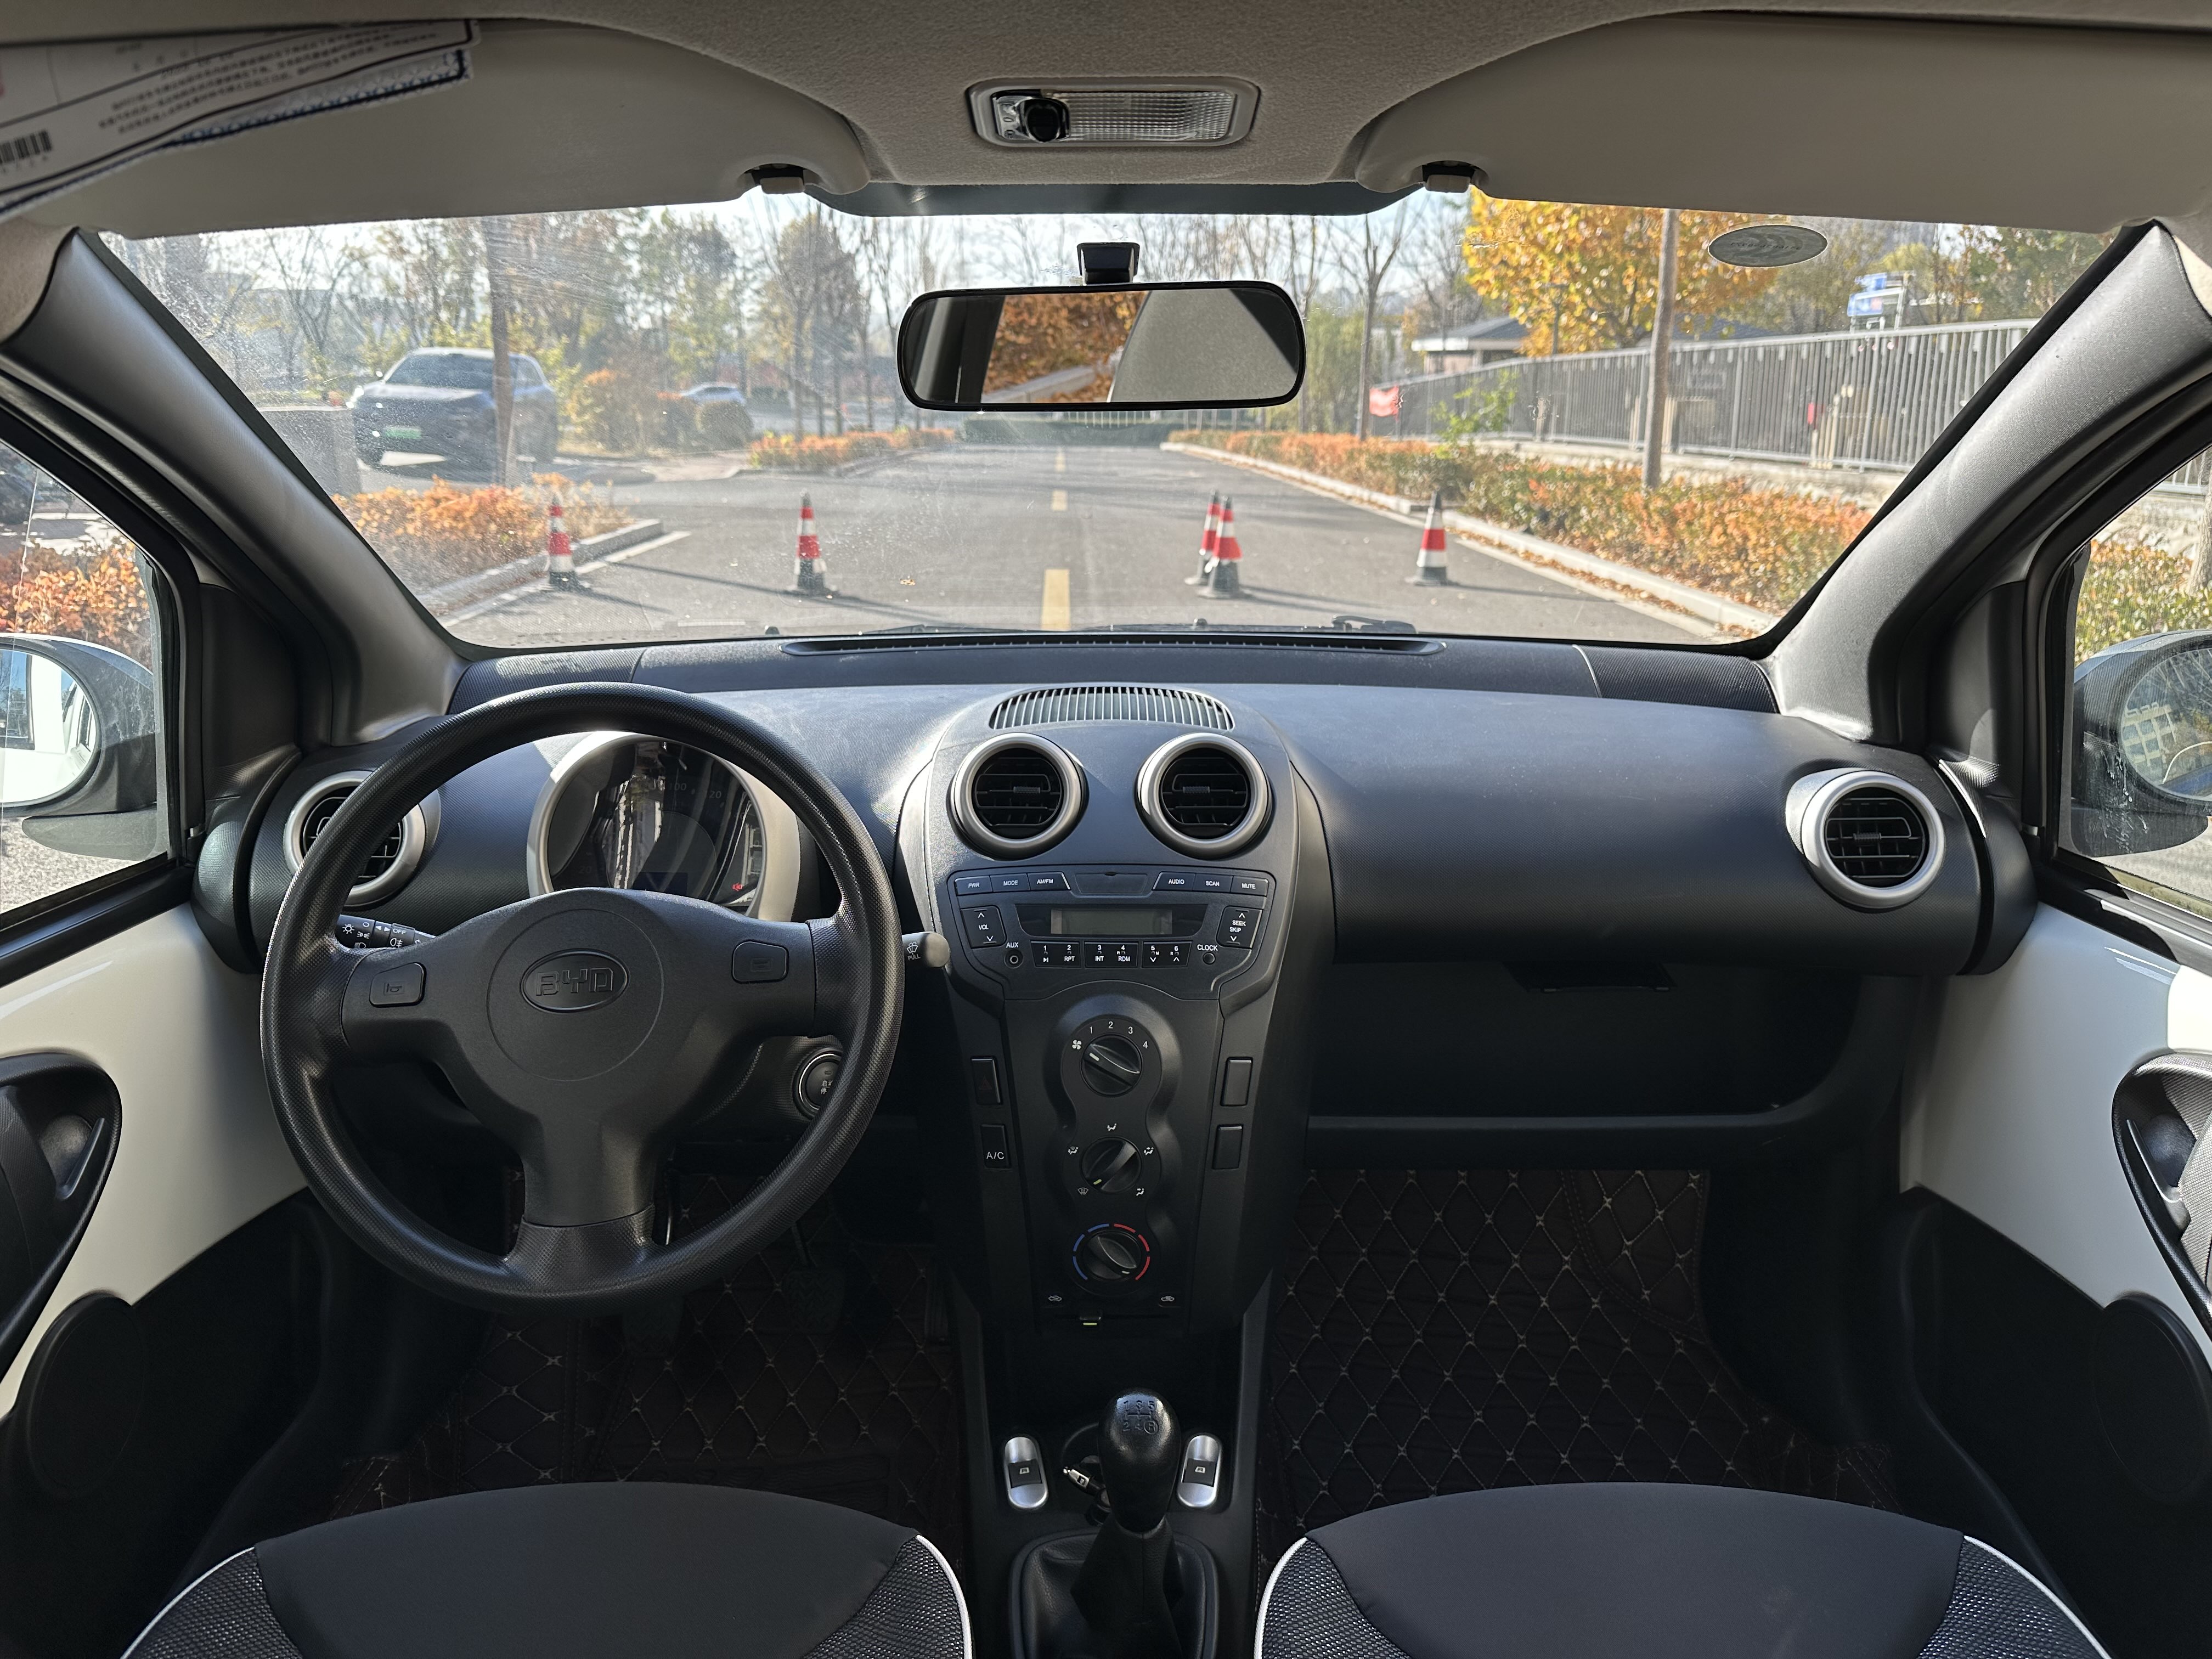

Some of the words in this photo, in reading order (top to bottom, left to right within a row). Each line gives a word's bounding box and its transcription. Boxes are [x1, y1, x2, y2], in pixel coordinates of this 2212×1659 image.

[707, 791, 722, 799] 20
[535, 967, 613, 996] BYD
[1090, 1026, 1093, 1034] 1
[986, 1151, 1005, 1160] A/C
[1124, 1400, 1129, 1410] 1
[1148, 1400, 1155, 1410] 5
[1123, 1421, 1130, 1431] 2
